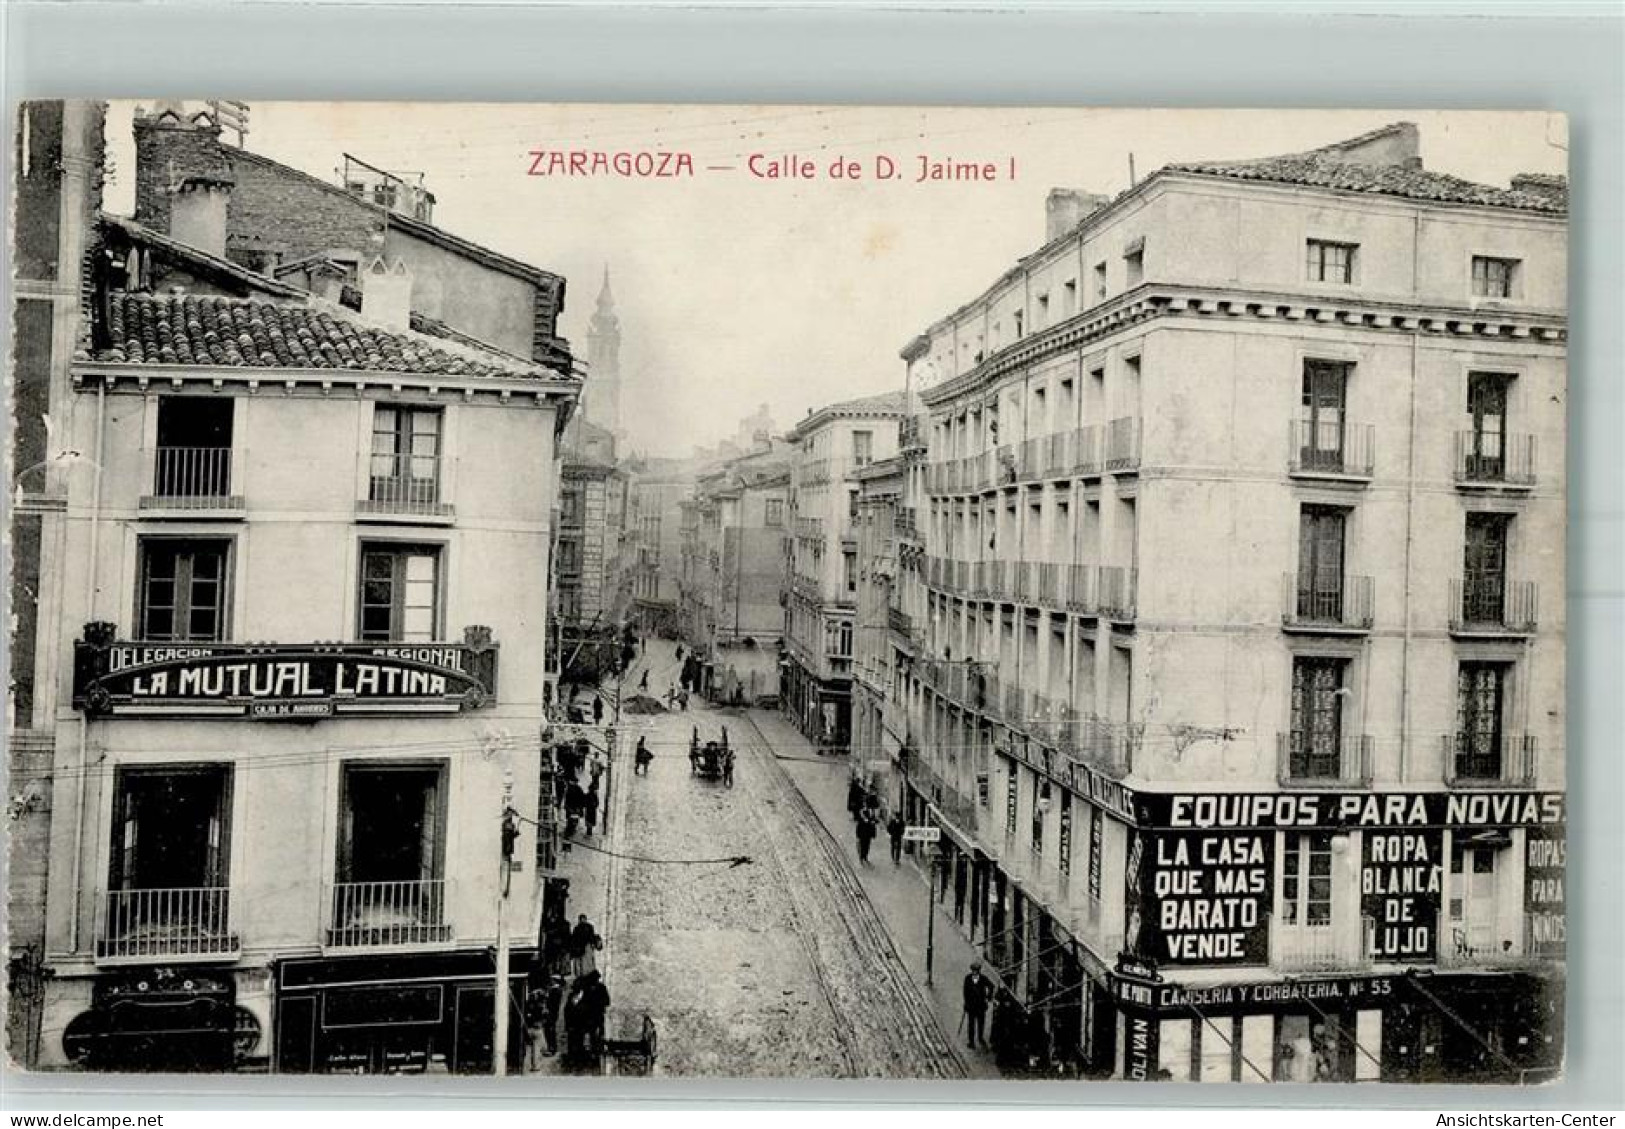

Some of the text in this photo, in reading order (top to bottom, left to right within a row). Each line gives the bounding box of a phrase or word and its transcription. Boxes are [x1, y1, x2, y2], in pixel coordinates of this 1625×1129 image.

[110, 648, 466, 675] DELEGACION REGIONAL
[133, 662, 446, 697] LA MUTUAL LATINA
[1170, 795, 1320, 829] EQUIPOS
[1338, 794, 1429, 826] PARA
[1157, 837, 1189, 866] LA
[1202, 837, 1265, 865] CASA
[1371, 835, 1429, 862] ROPA
[1155, 869, 1265, 898] QUE MAS
[1362, 865, 1441, 894] BLANCA
[1532, 880, 1564, 901] PARA
[1160, 898, 1258, 930] BARATO
[1386, 899, 1414, 922] DE
[1166, 933, 1246, 959] VENDE
[1368, 926, 1429, 956] LUJO
[1239, 987, 1248, 1001] Y
[1371, 979, 1392, 995] 53
[1131, 1018, 1149, 1080] OLIVAN
